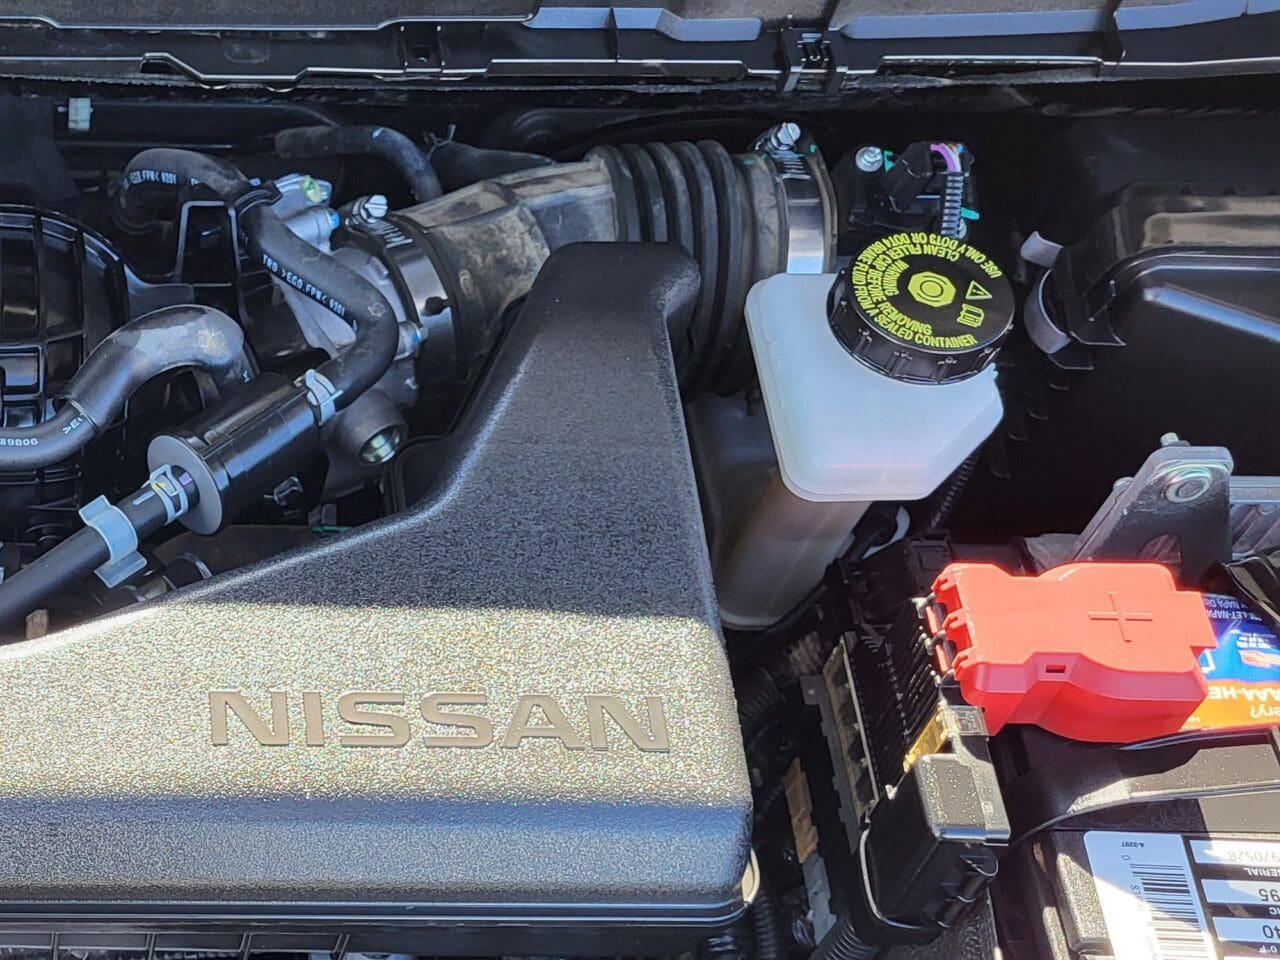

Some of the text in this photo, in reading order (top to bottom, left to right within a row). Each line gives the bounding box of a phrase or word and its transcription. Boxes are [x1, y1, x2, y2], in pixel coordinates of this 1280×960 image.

[851, 232, 1003, 349] USE ONLY DOT3 OR DOT4 BRAKE FLUID FROM A SEALED CONTAINER
[866, 244, 961, 336] CLEAN FILLER CAP BEFORE REMOVING
[882, 259, 910, 297] WARNING
[208, 689, 670, 753] NISSAN
